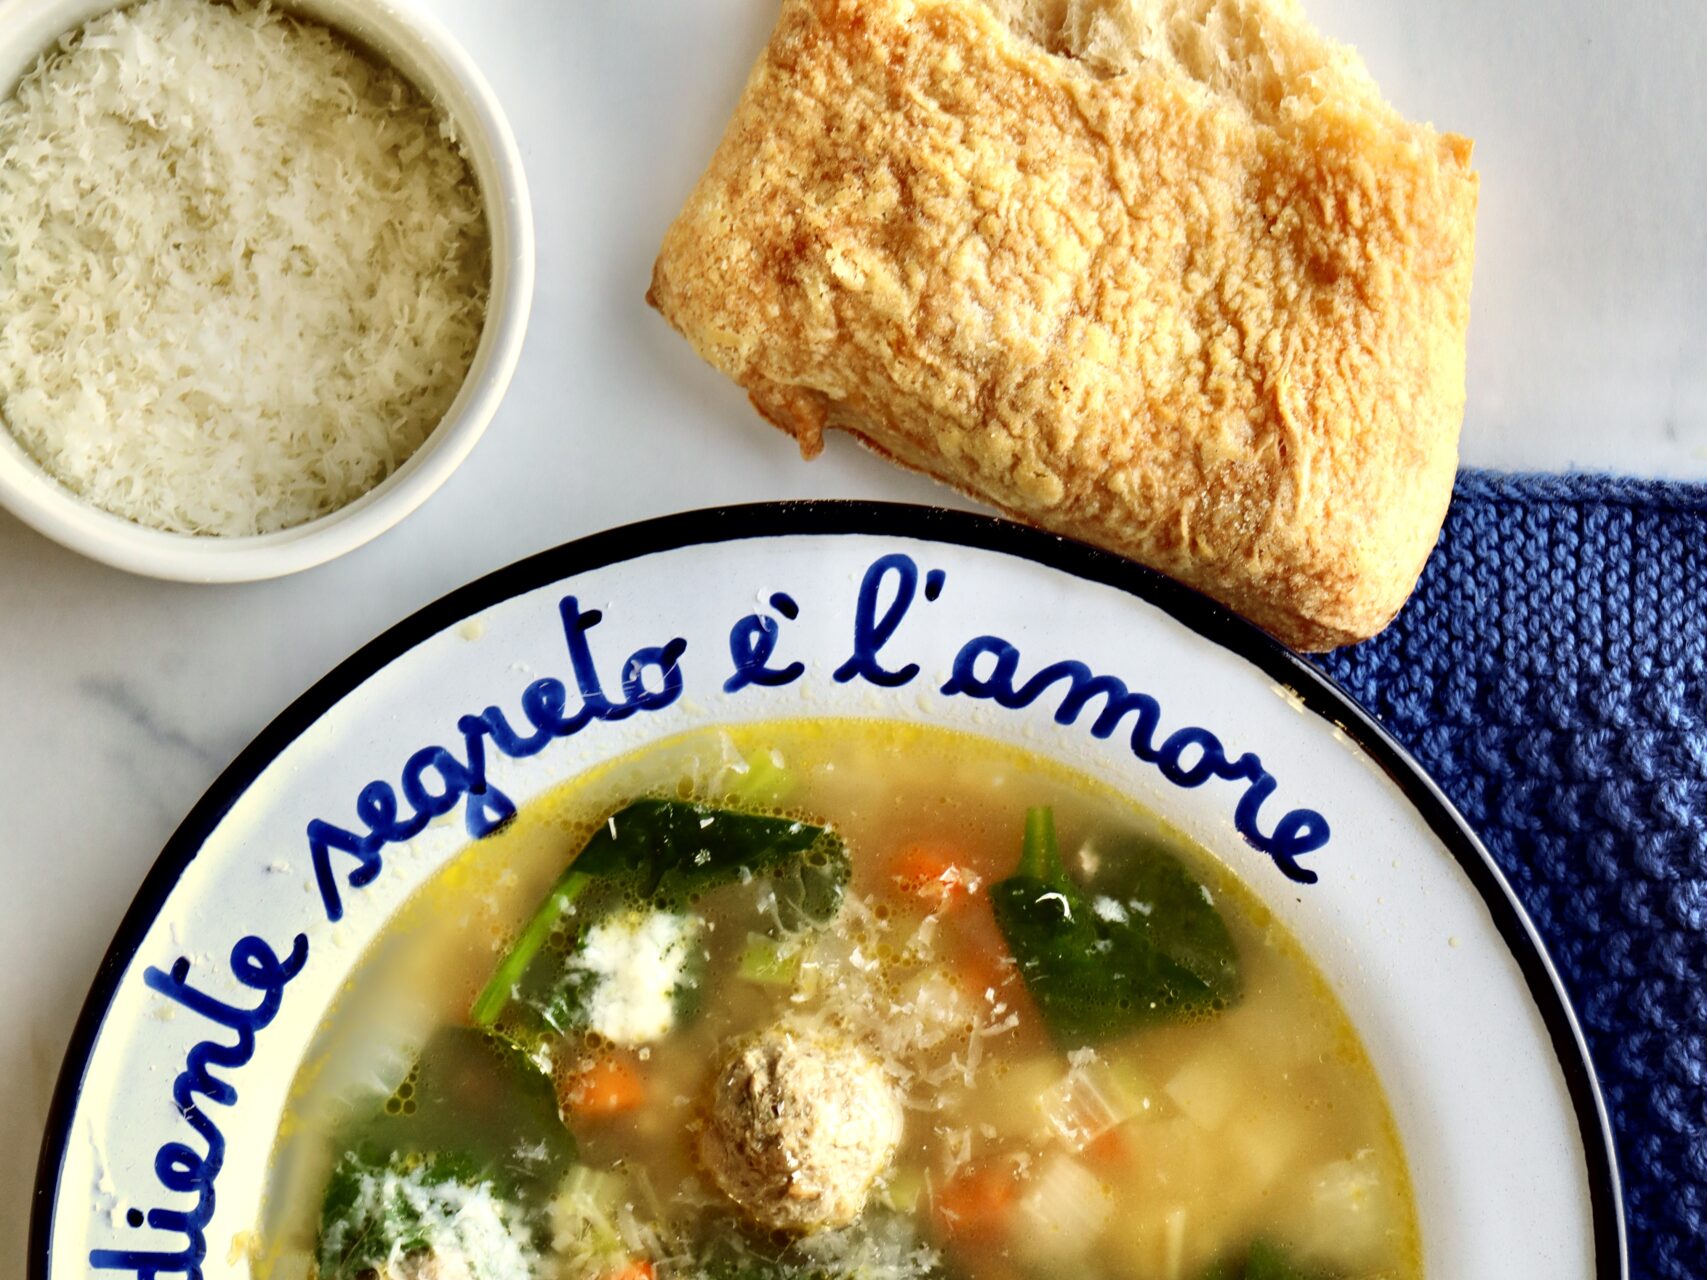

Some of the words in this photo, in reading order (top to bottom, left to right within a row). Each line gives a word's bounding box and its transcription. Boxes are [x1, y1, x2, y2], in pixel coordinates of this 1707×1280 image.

[306, 595, 687, 922] segreto
[723, 592, 805, 694] è
[832, 553, 1331, 885] l'amore
